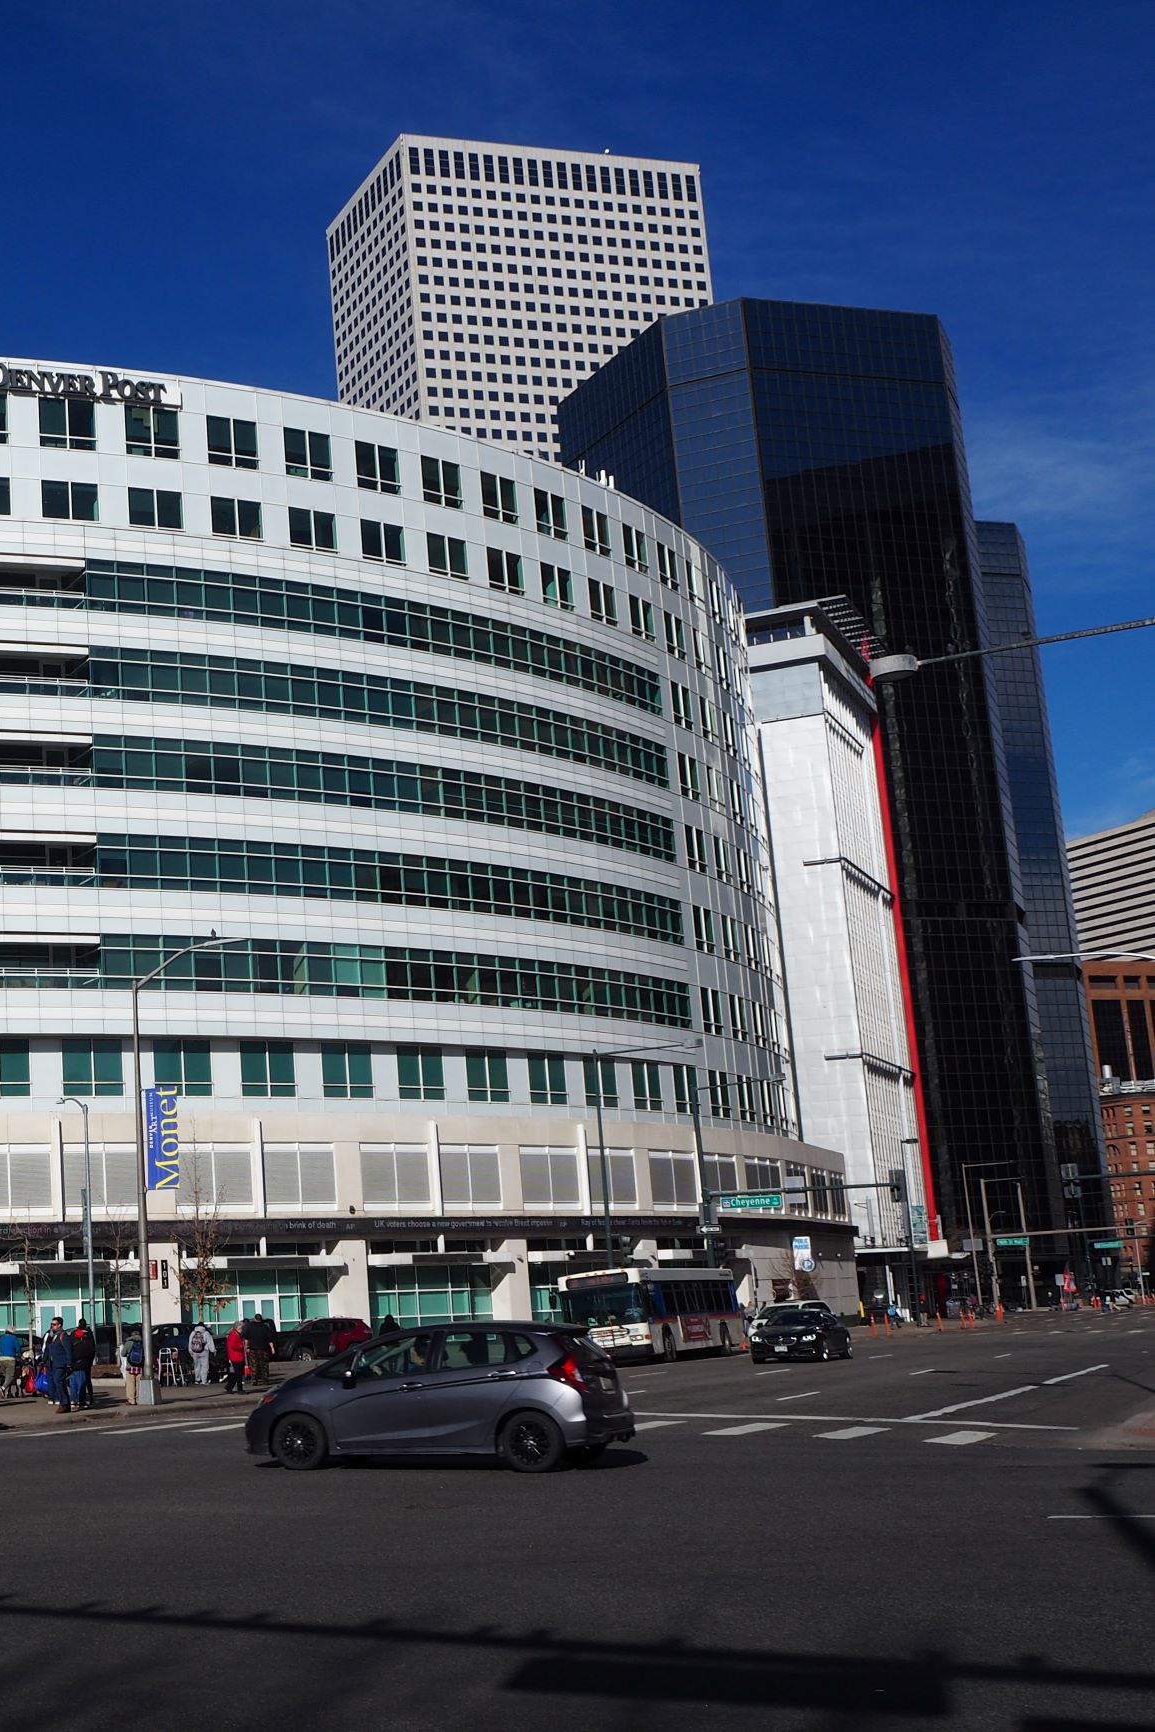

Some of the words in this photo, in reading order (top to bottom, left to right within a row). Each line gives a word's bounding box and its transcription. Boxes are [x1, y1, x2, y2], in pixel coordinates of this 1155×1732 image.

[154, 1085, 181, 1190] Monet
[730, 1197, 771, 1208] Cheyenne
[289, 1220, 307, 1229] brink
[307, 1220, 316, 1229] of
[316, 1220, 336, 1229] death
[374, 1220, 385, 1229] UK
[386, 1220, 407, 1229] voters
[407, 1219, 431, 1228] choose
